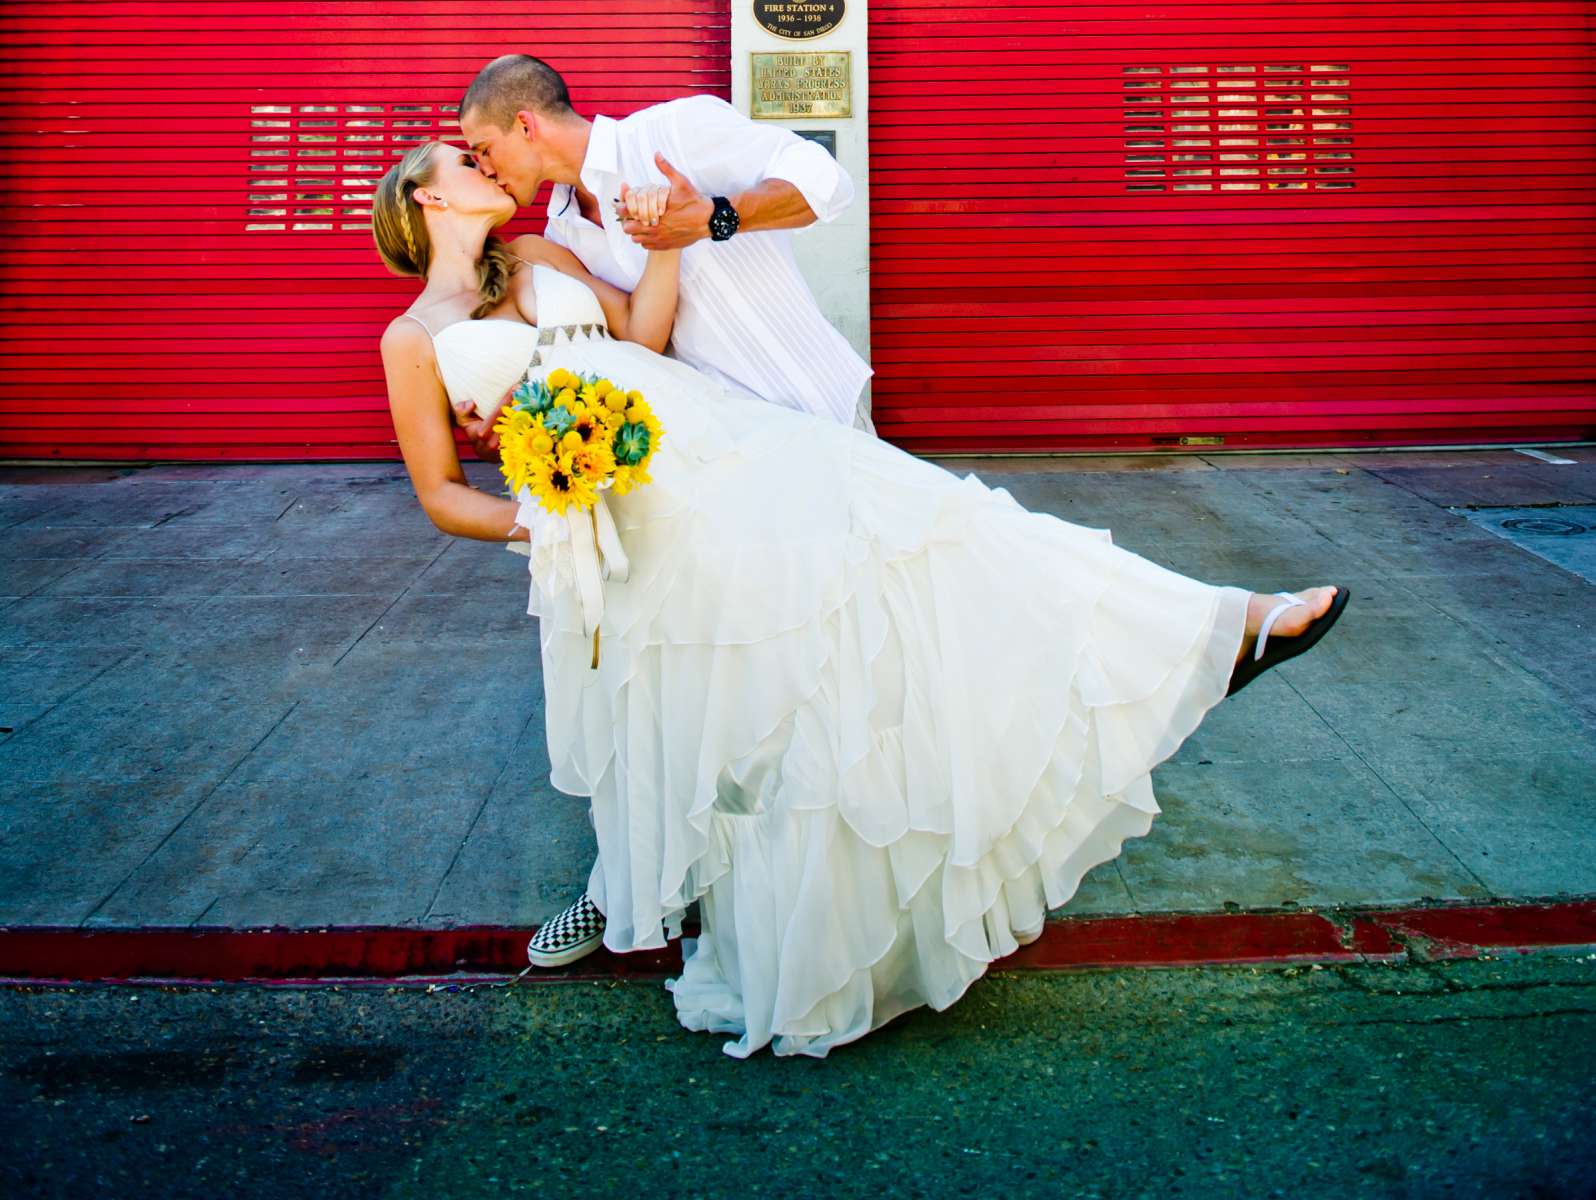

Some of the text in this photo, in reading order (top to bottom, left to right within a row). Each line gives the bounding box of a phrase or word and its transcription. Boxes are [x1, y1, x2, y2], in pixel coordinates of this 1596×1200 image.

[764, 4, 835, 12] FIRE STATION 4
[777, 14, 795, 22] 1936
[767, 23, 778, 32] THE
[778, 28, 792, 36] CITY
[816, 22, 833, 33] DIEGO
[777, 55, 825, 66] BUILT BY
[760, 67, 841, 78] UNITED STATES
[796, 78, 846, 89] PROGRESS
[761, 90, 841, 101] ADMINISTRATION
[790, 102, 813, 113] 1937
